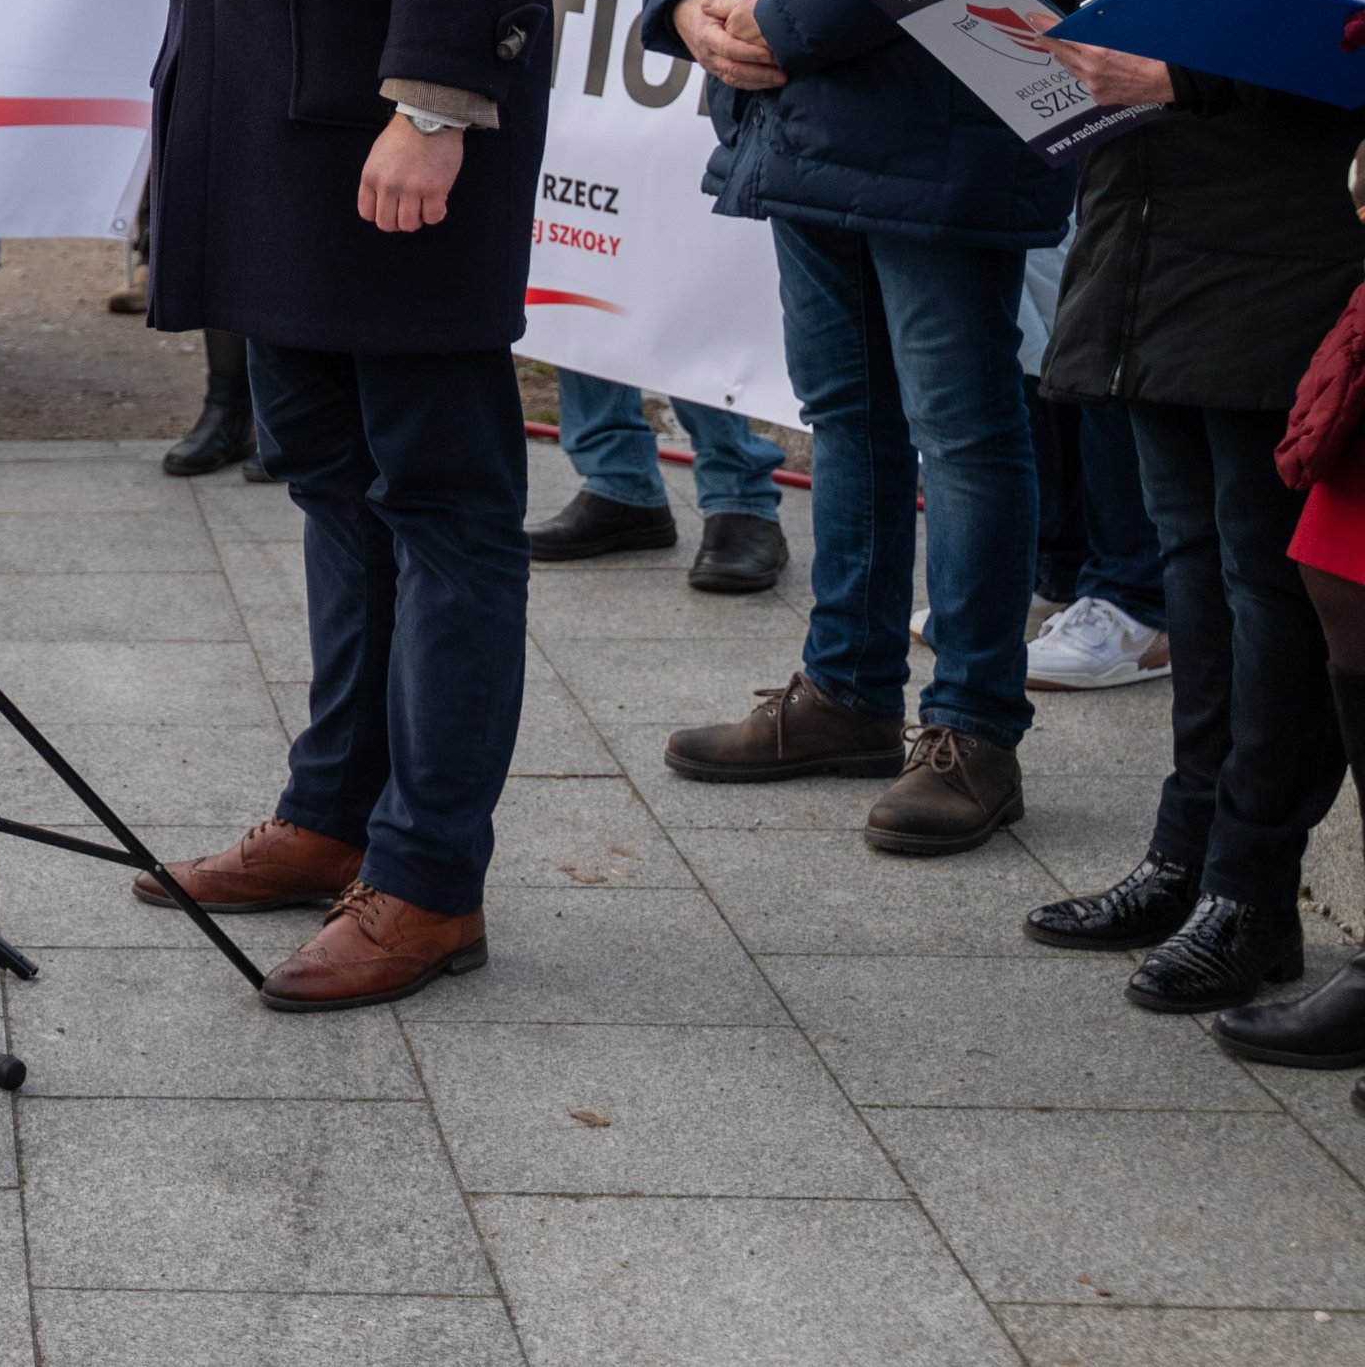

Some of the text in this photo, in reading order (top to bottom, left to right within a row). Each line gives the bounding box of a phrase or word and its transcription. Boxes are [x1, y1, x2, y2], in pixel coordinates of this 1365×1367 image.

[1015, 78, 1053, 101] RUCH
[541, 172, 620, 215] RZECZ
[548, 221, 622, 257] SZKOŁY
